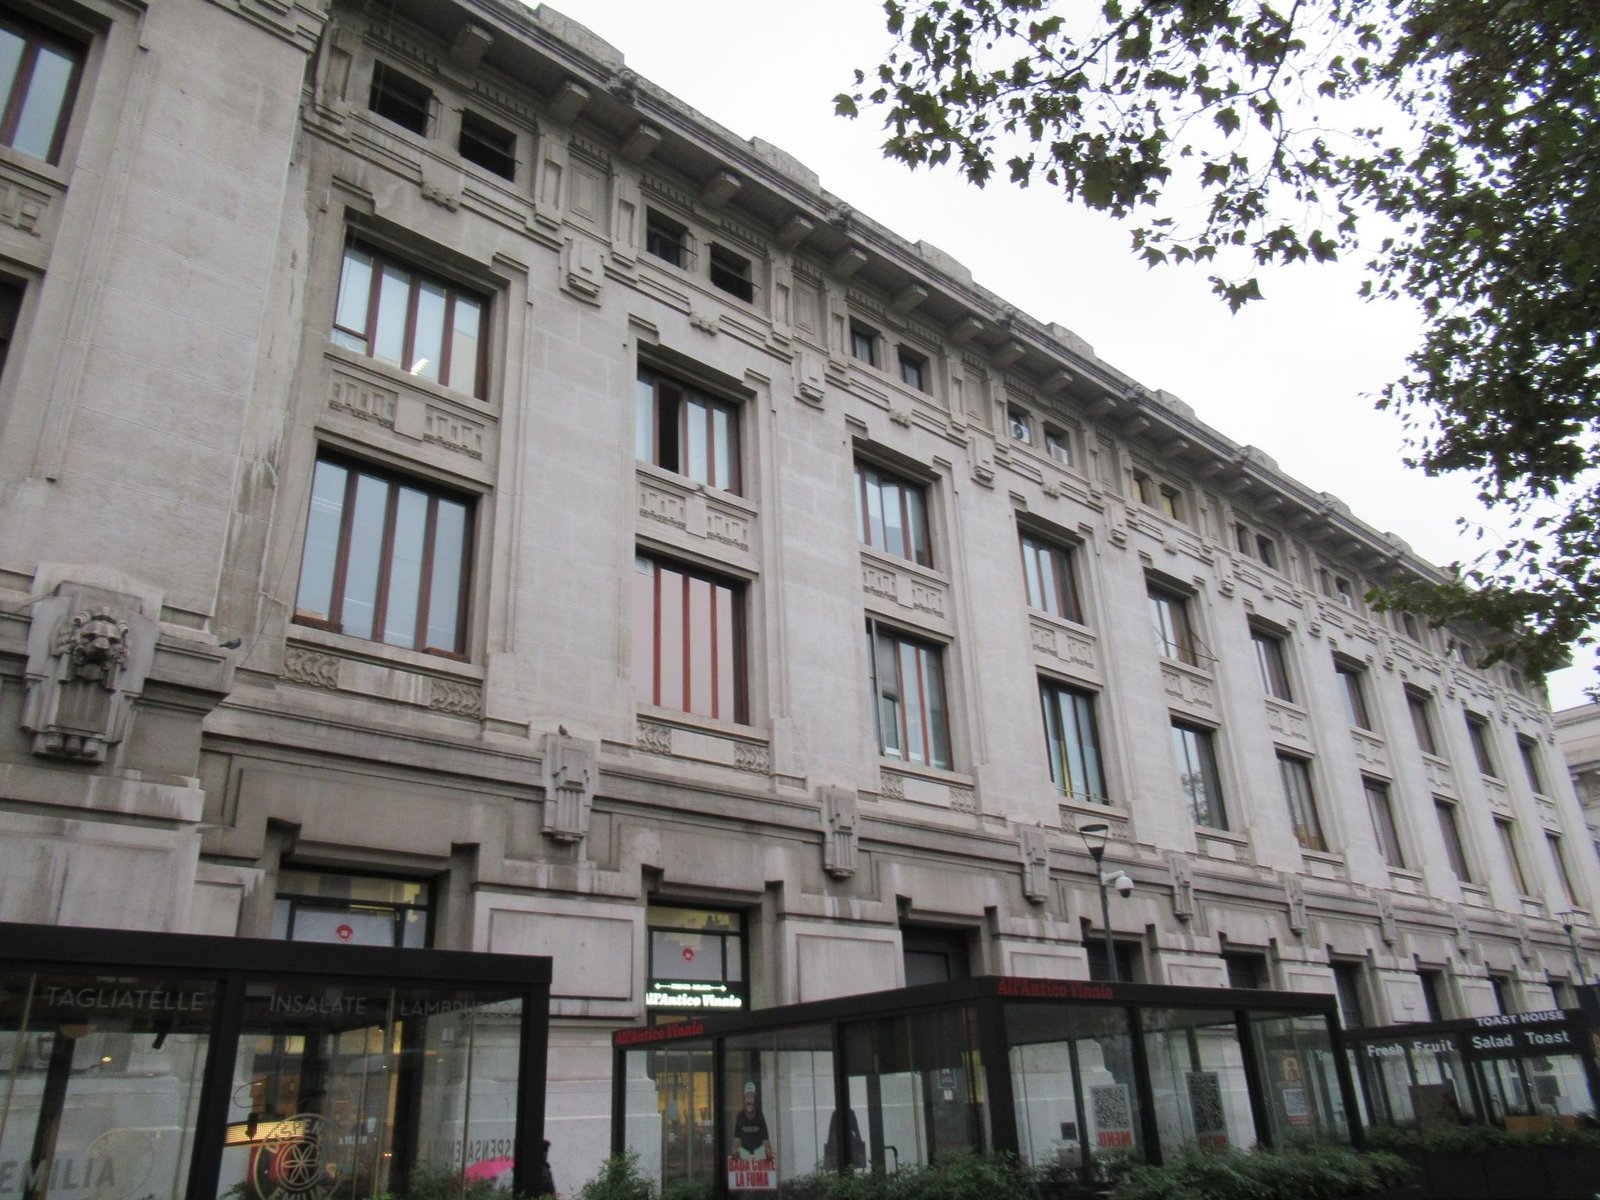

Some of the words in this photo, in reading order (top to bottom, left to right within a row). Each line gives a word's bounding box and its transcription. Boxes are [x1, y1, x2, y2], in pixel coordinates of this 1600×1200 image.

[47, 986, 205, 1011] TAGLIATELLE
[269, 995, 367, 1015] INSALATE
[646, 992, 701, 1007] ll'Antico
[400, 1000, 513, 1018] LAMBRUSCO
[1475, 1014, 1518, 1027] TOAST
[1521, 1010, 1566, 1023] HOUSE
[1367, 1043, 1405, 1057] Fresh
[1413, 1039, 1454, 1053] Fruit
[1472, 1034, 1514, 1049] Salad
[1525, 1029, 1570, 1046] Toast
[0, 1156, 115, 1194] EMILIA
[736, 1172, 745, 1188] LA
